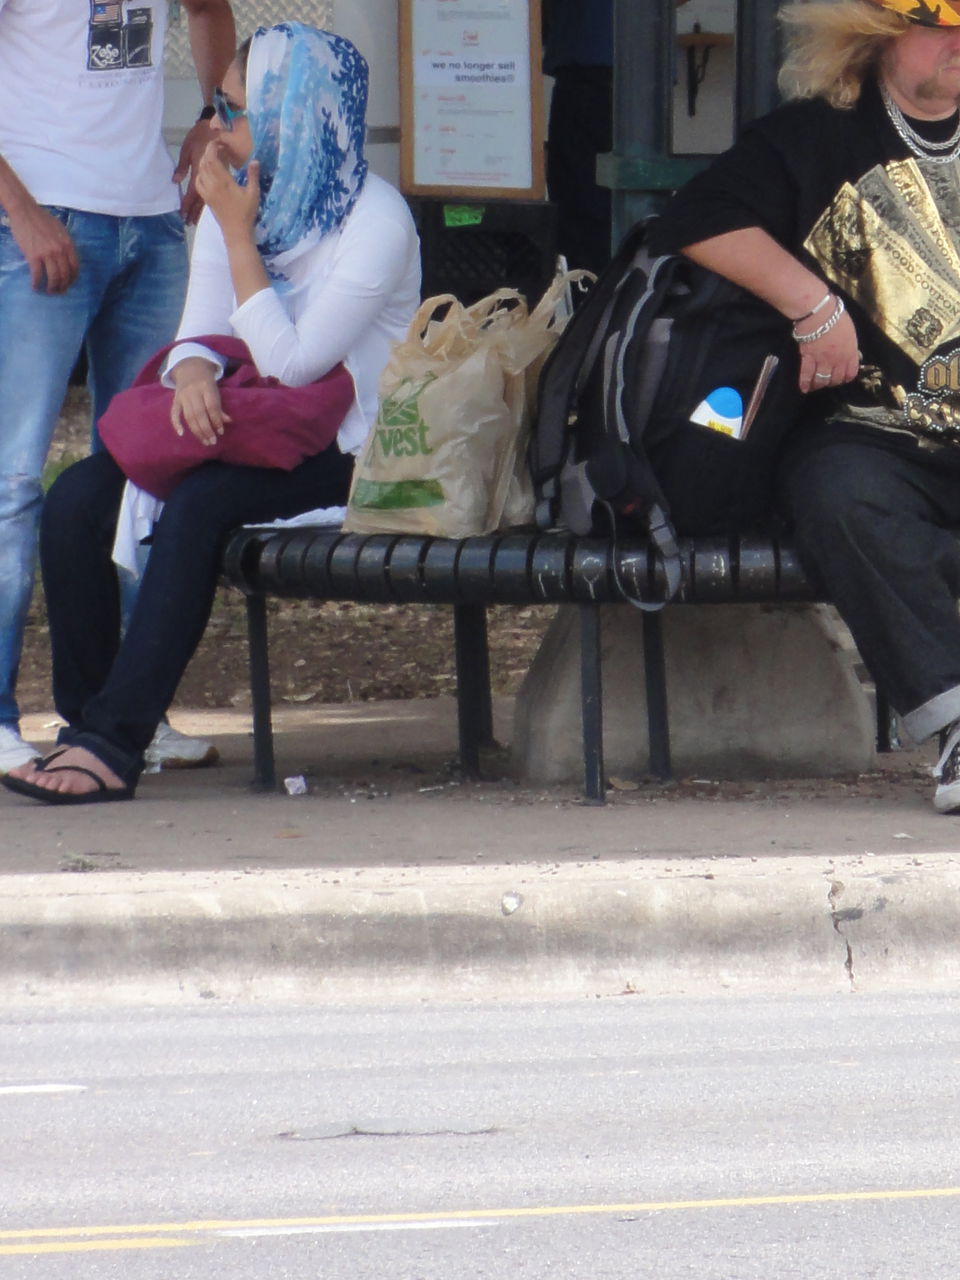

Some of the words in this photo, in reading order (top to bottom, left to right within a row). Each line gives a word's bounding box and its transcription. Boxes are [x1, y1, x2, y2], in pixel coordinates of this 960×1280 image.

[432, 62, 446, 70] we
[449, 62, 461, 70] no
[463, 61, 495, 71] longer
[498, 61, 516, 70] sell
[884, 243, 915, 274] FOOD
[914, 273, 960, 317] COUPON
[374, 418, 434, 459] vest
